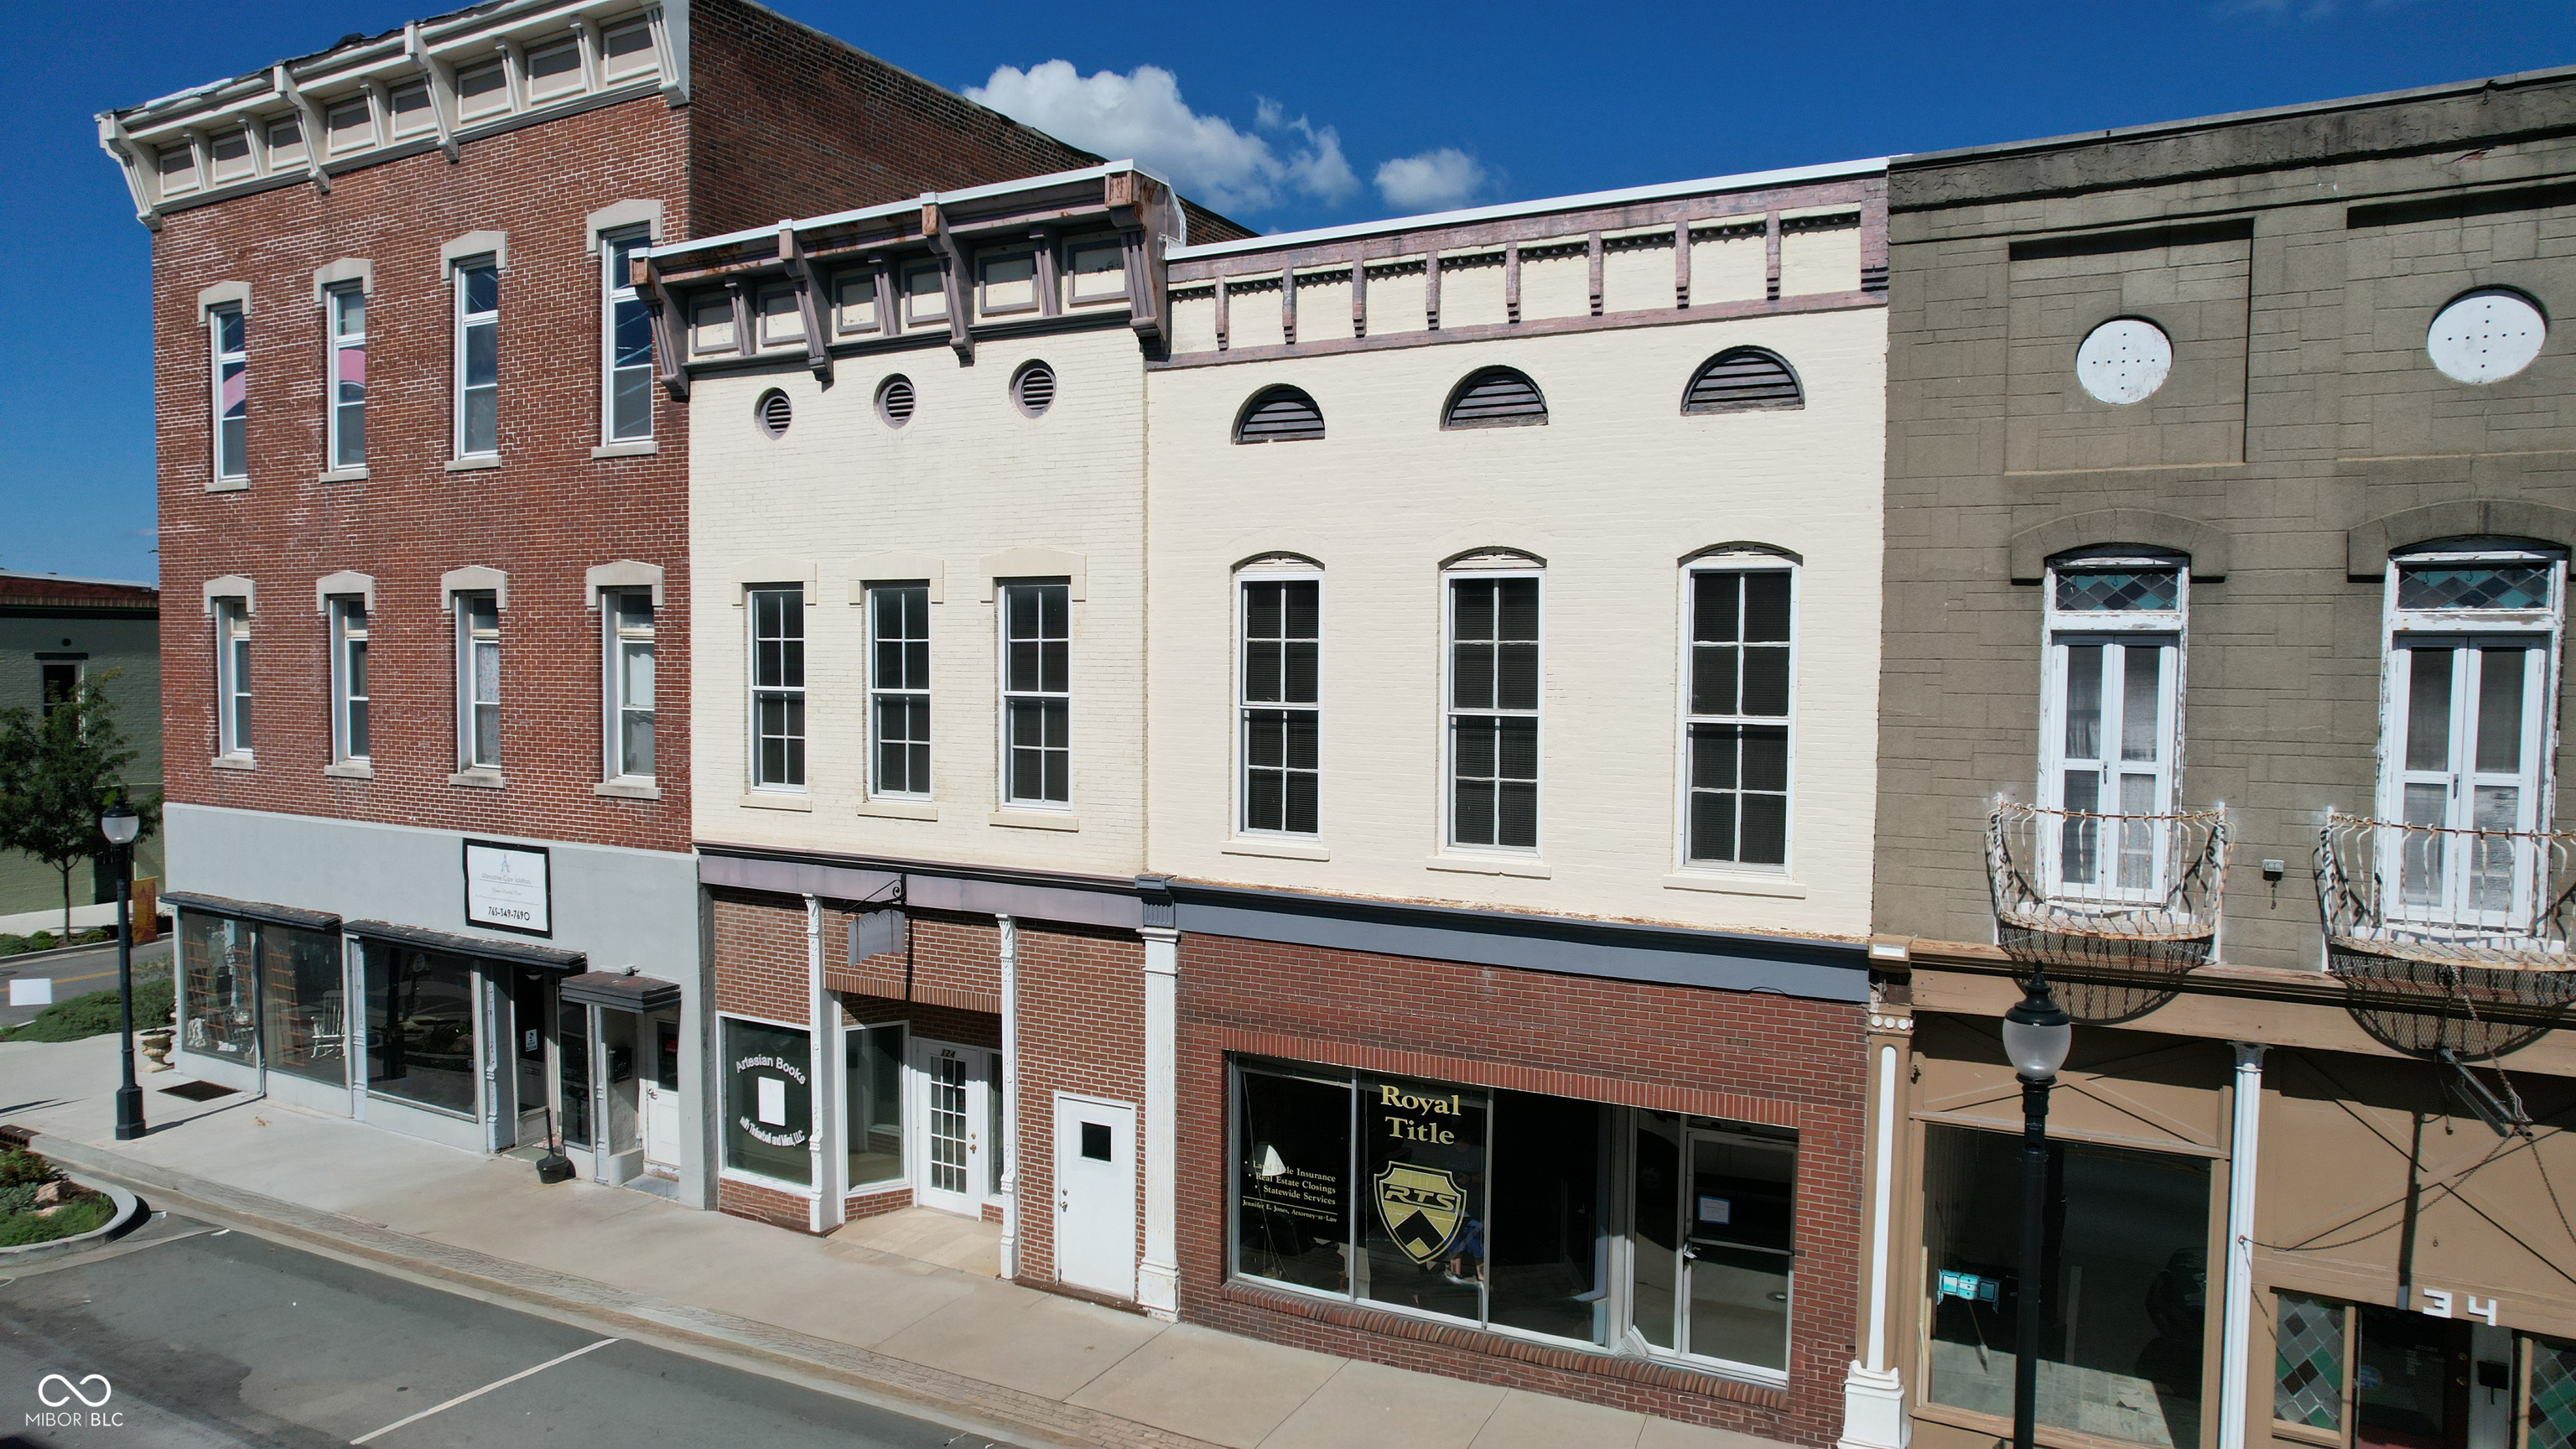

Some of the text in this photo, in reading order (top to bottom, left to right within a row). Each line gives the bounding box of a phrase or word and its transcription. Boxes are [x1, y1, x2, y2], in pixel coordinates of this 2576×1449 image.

[488, 906, 531, 921] 765-349-7690
[941, 1048, 956, 1058] 124
[735, 1054, 806, 1084] Artesian Books
[1379, 1084, 1462, 1116] Royal
[771, 1135, 782, 1146] and
[792, 1130, 805, 1145] LLC
[1384, 1116, 1455, 1145] Title
[1253, 1160, 1272, 1171] Land
[1296, 1168, 1337, 1182] Insurance
[1255, 1171, 1336, 1195] Real Estate Closings
[1264, 1184, 1336, 1205] Statewide Services
[1242, 1199, 1265, 1209] Jennifer
[1273, 1206, 1290, 1214] Jones,
[1384, 1185, 1456, 1211] RTS
[2423, 1288, 2497, 1327] 34
